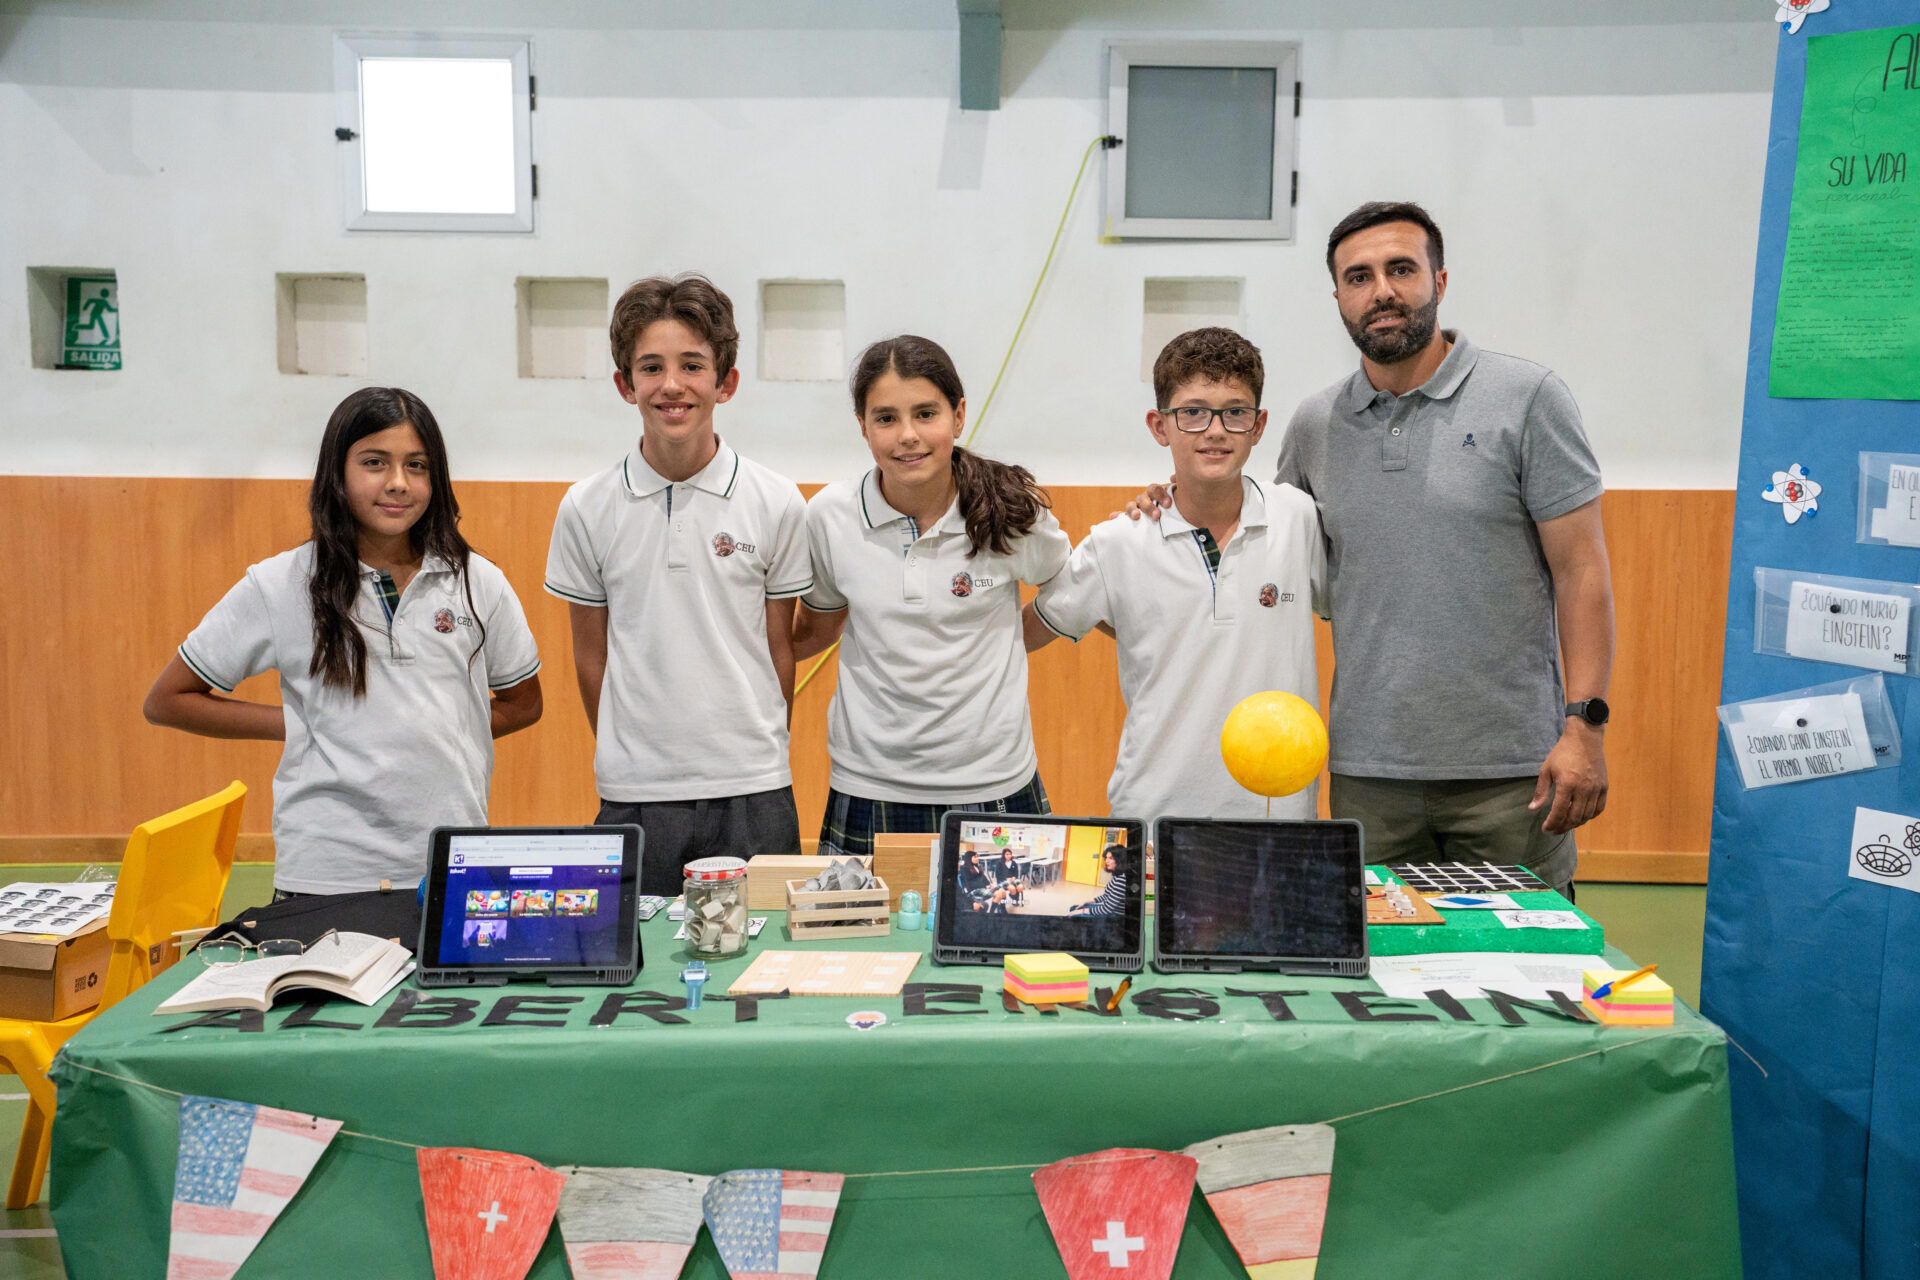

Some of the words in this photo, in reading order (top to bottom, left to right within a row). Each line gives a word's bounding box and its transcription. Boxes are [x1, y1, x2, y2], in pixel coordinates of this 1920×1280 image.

[1827, 155, 1855, 187] SU
[1864, 152, 1906, 184] VIDA
[1817, 187, 1911, 213] personal
[71, 352, 120, 363] SALIDA
[1892, 469, 1906, 490] EN
[735, 542, 756, 553] CEU
[974, 578, 994, 588] CEU
[1281, 592, 1295, 602] CEU
[1861, 599, 1898, 620] MURIÓ
[457, 616, 473, 628] CEU
[1822, 619, 1892, 650] EINSTEIN?
[1813, 728, 1853, 749] EINSTEIN
[1758, 759, 1771, 779] EL
[1773, 757, 1803, 778] PREMIO
[1806, 752, 1845, 776] NOBEL?
[157, 988, 790, 1034] ALBERT
